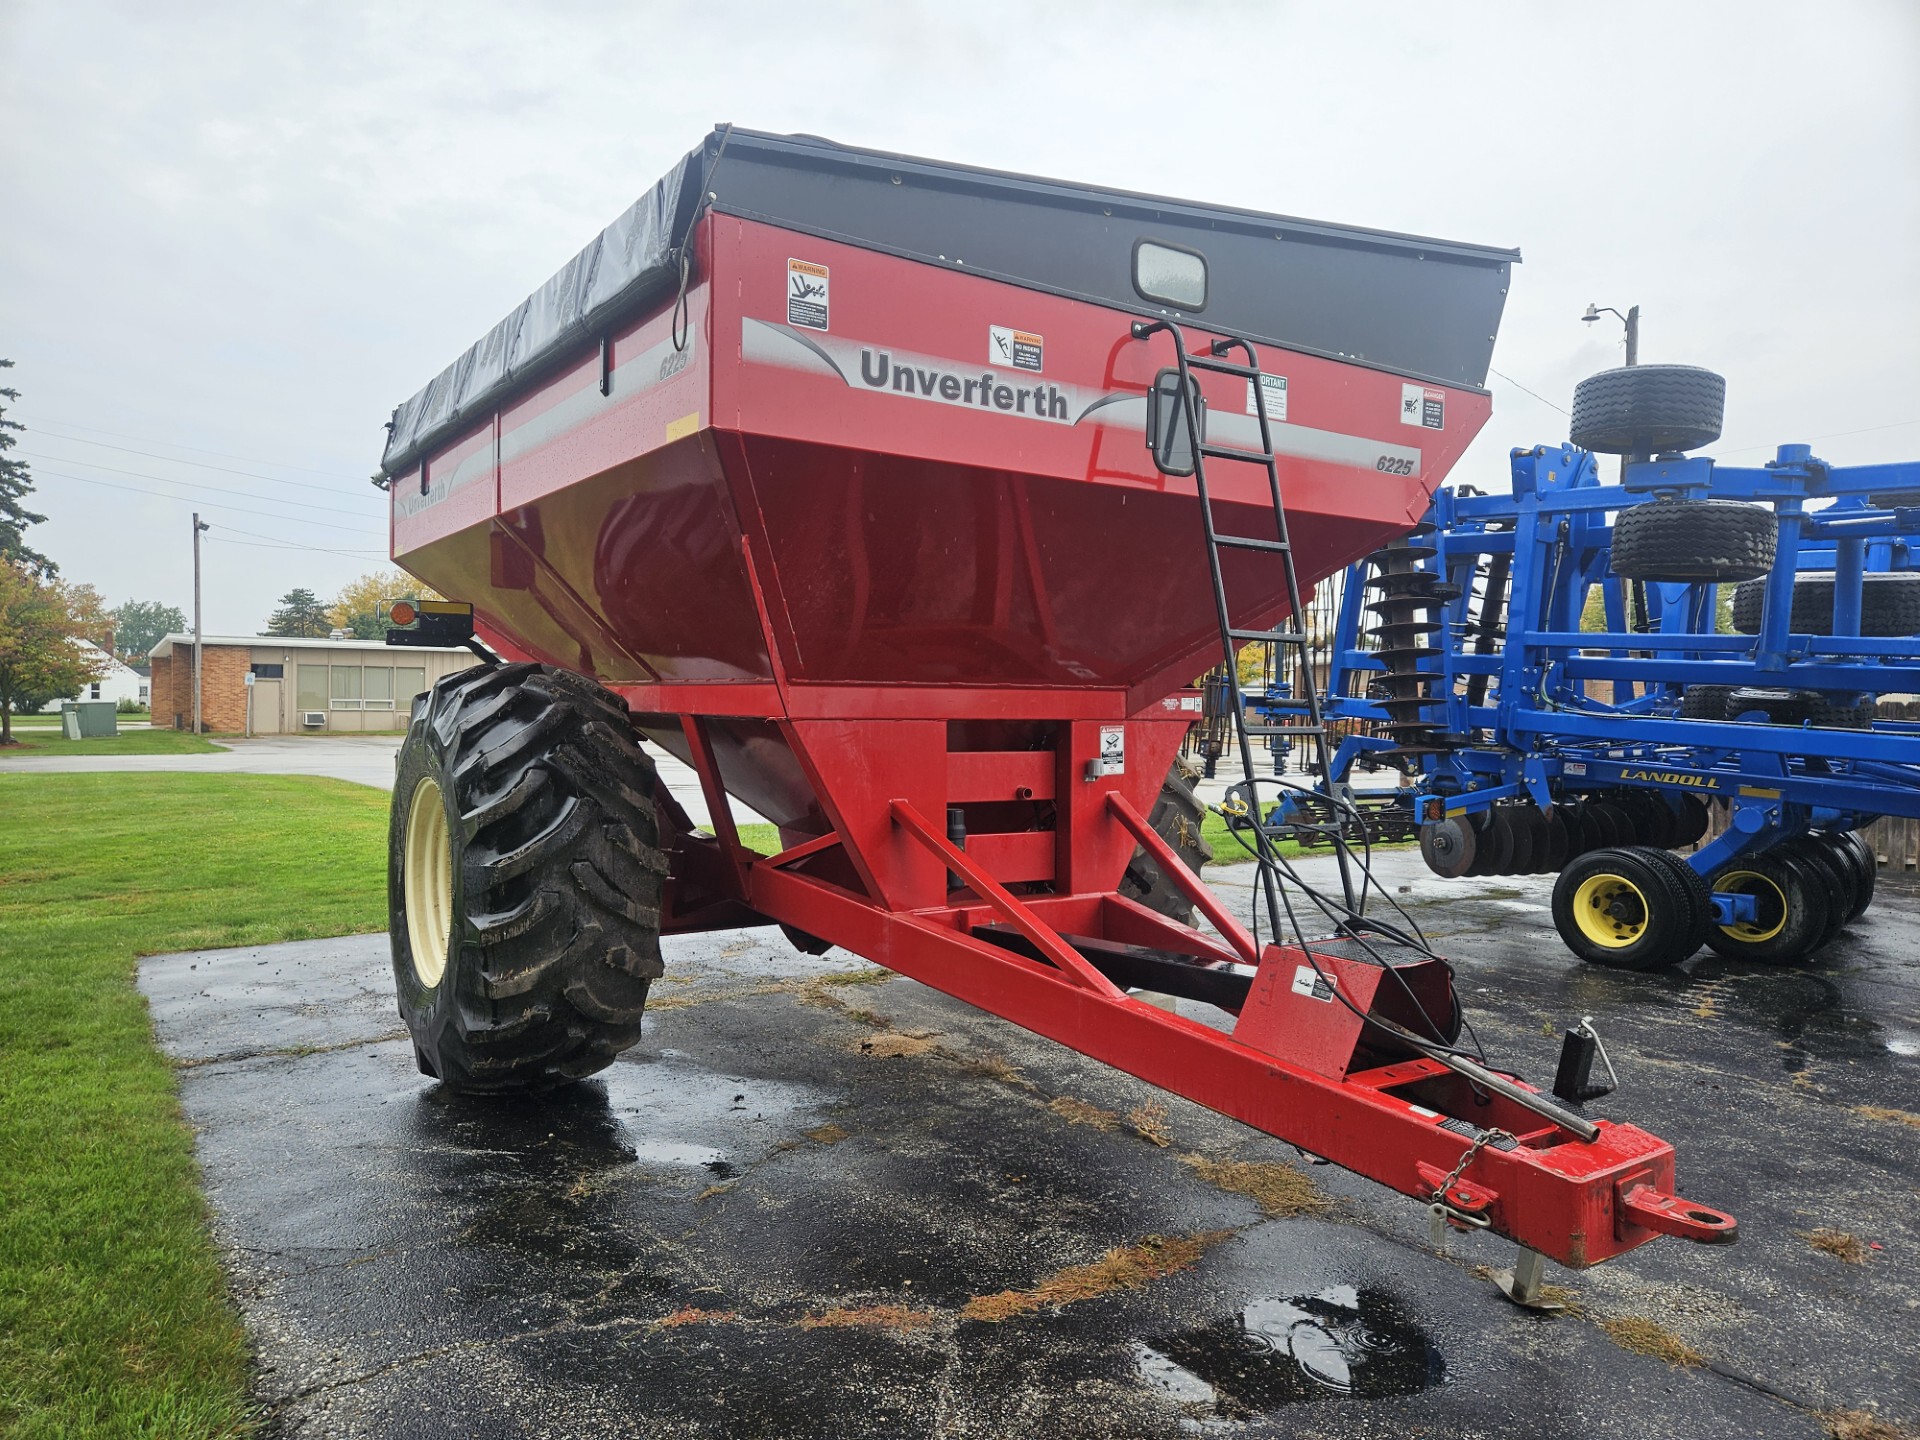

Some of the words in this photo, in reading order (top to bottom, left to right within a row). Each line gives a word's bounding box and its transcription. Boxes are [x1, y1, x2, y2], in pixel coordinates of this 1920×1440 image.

[798, 264, 825, 275] WARNING
[1019, 335, 1041, 344] WARNING
[1022, 345, 1040, 354] RIDERS
[659, 342, 690, 381] 6225
[861, 348, 1068, 420] Unverferth
[1258, 375, 1285, 388] ORTANT
[1376, 455, 1415, 476] 6225
[1620, 769, 1720, 789] LANDOLL
